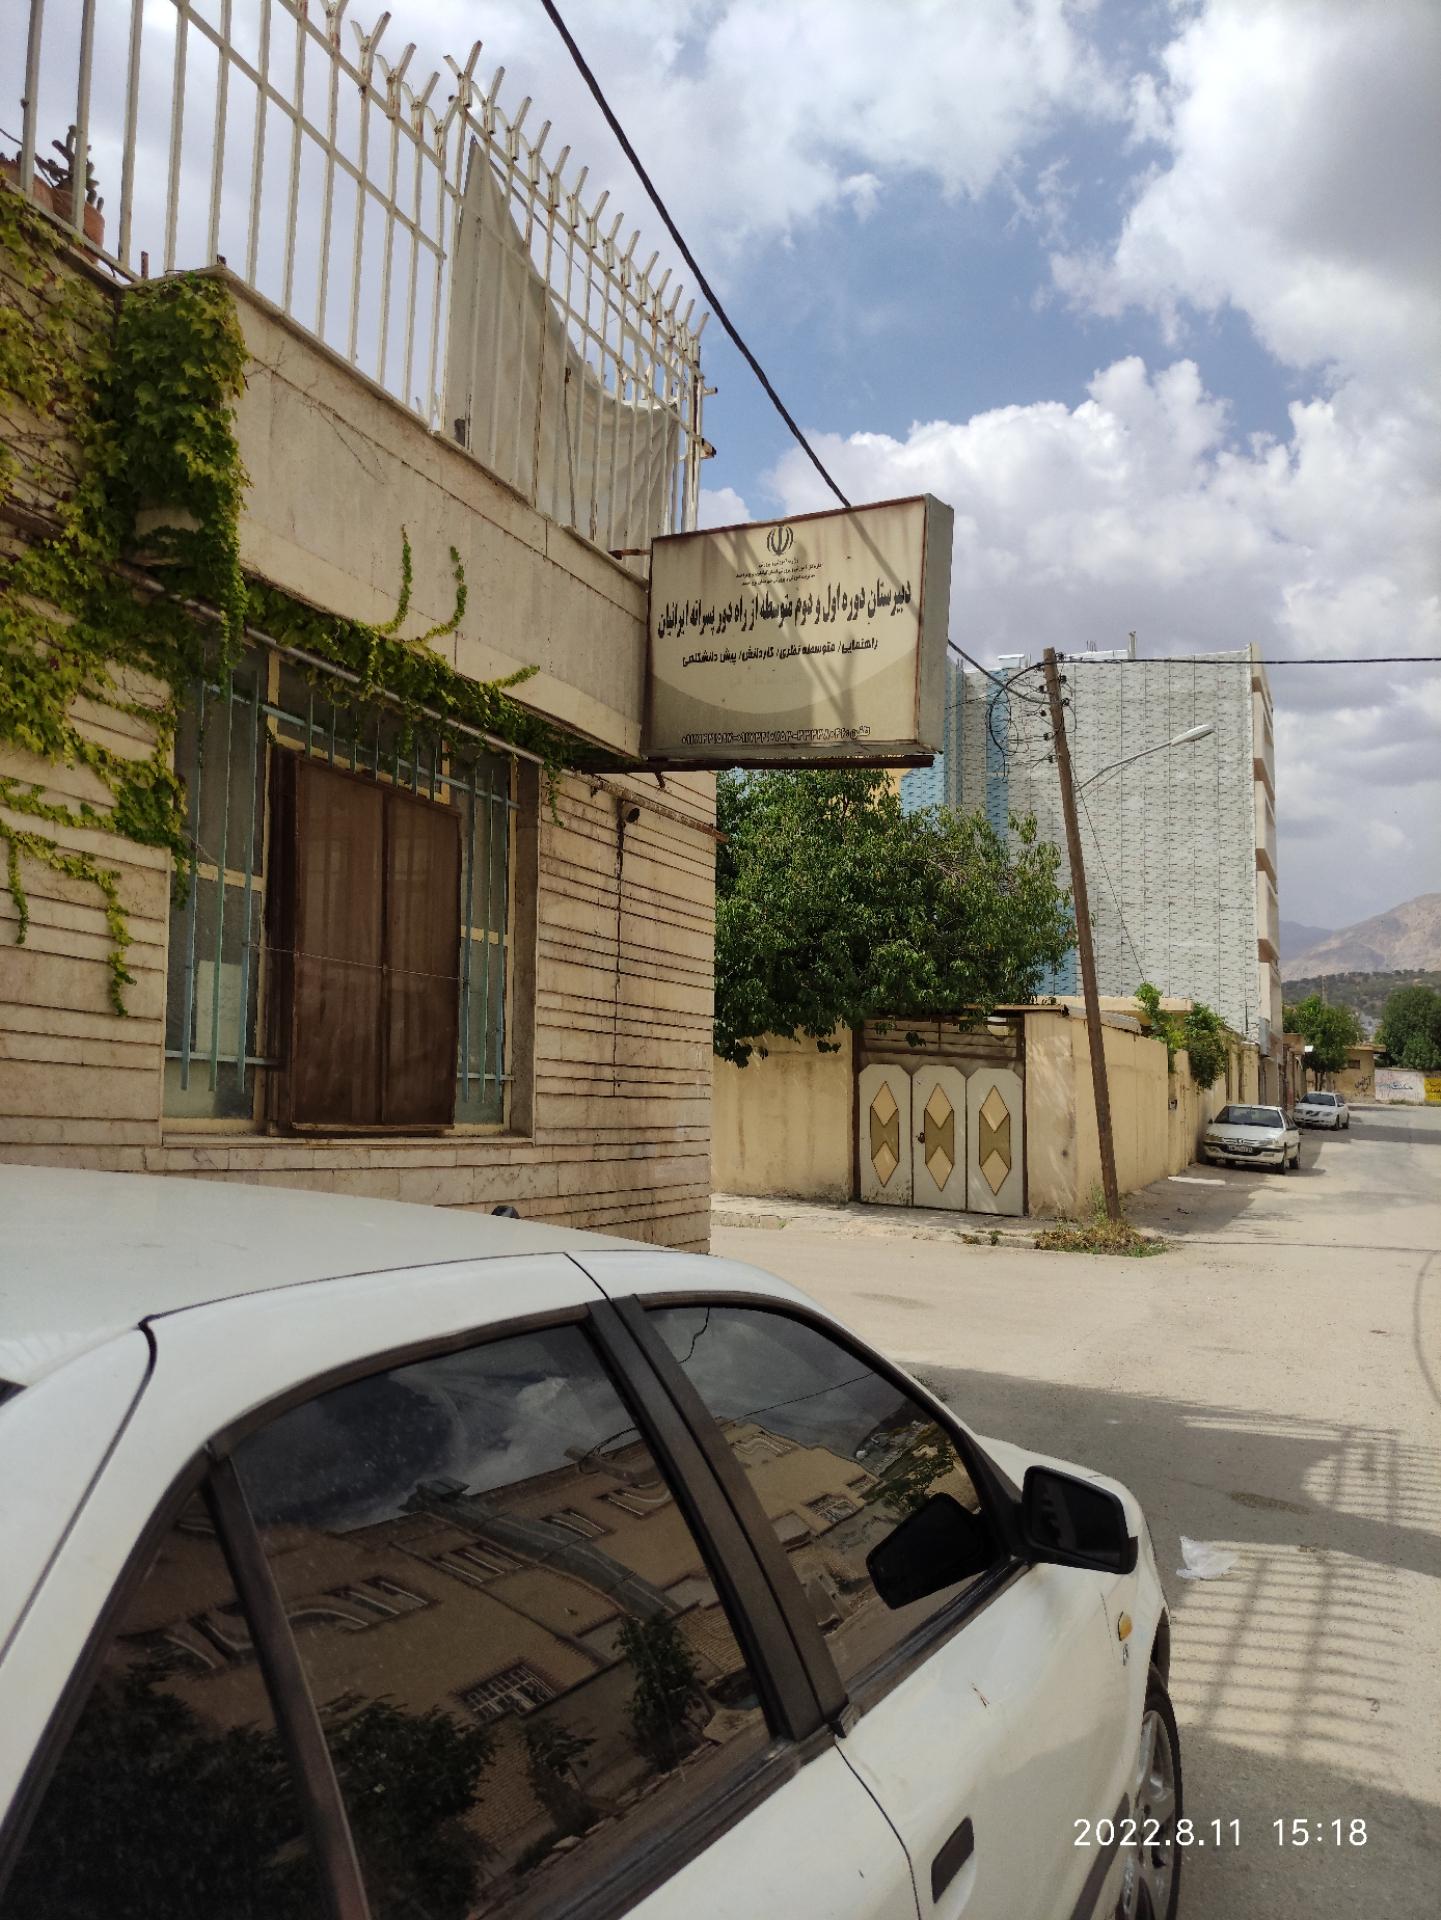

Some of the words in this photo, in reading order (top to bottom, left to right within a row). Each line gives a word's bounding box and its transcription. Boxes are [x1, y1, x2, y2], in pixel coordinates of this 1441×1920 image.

[735, 595, 747, 631] راه
[749, 593, 759, 631] از
[760, 590, 793, 628] متوسطه
[795, 593, 813, 626] دوم
[815, 595, 820, 624] و
[823, 582, 841, 622] اول
[842, 587, 865, 621] دوره
[868, 578, 911, 618] دبیرستان
[658, 600, 688, 638] ایرانیان
[690, 599, 714, 635] پسرانه
[716, 601, 732, 634] دور
[720, 648, 737, 665] پیش
[802, 642, 835, 655] متوسطه
